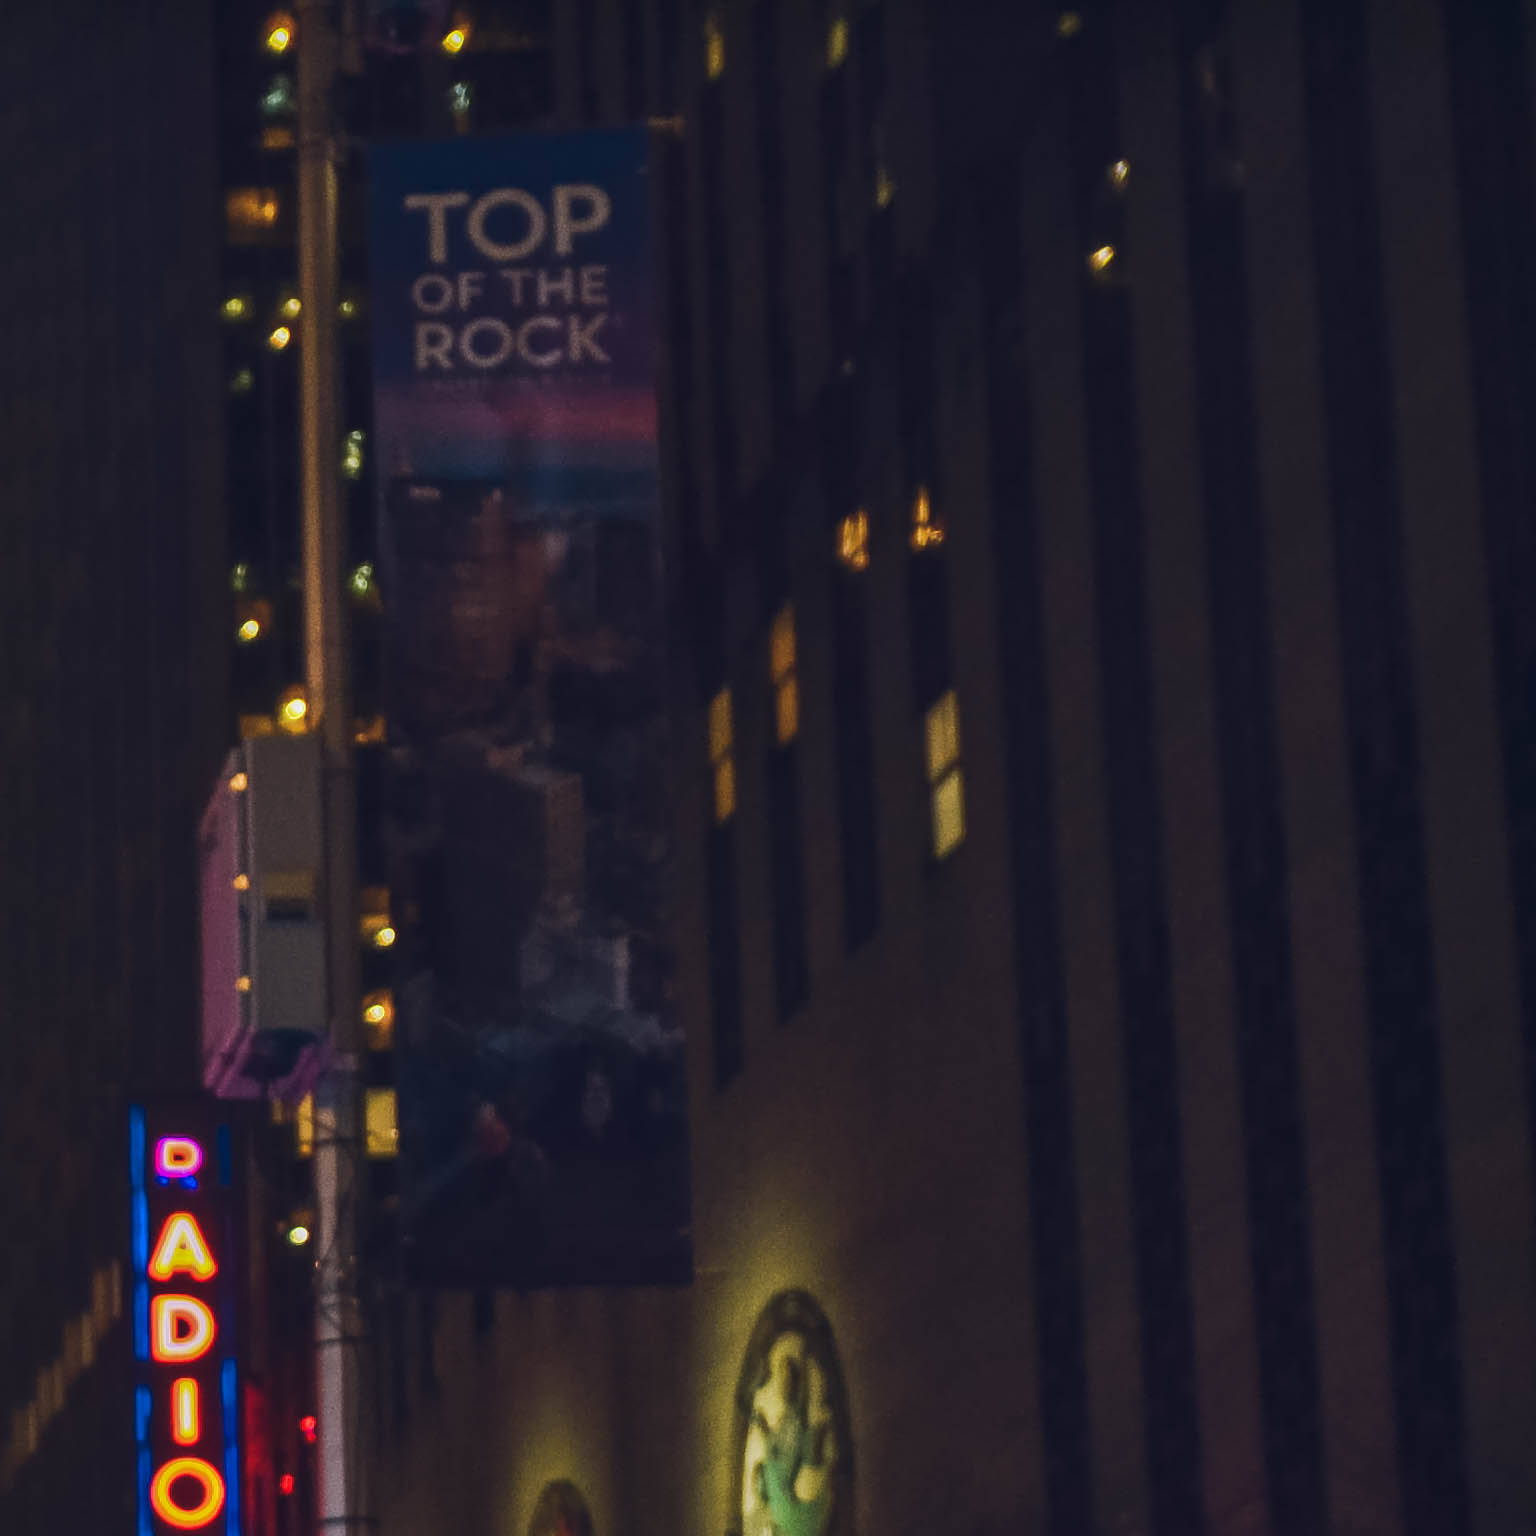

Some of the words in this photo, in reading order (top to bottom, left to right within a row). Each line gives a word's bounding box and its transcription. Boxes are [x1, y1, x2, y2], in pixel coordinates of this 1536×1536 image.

[403, 183, 612, 263] TOP
[412, 271, 484, 313] OF
[500, 264, 610, 306] THE
[413, 312, 612, 369] ROCK
[147, 1136, 226, 1530] RADIO
